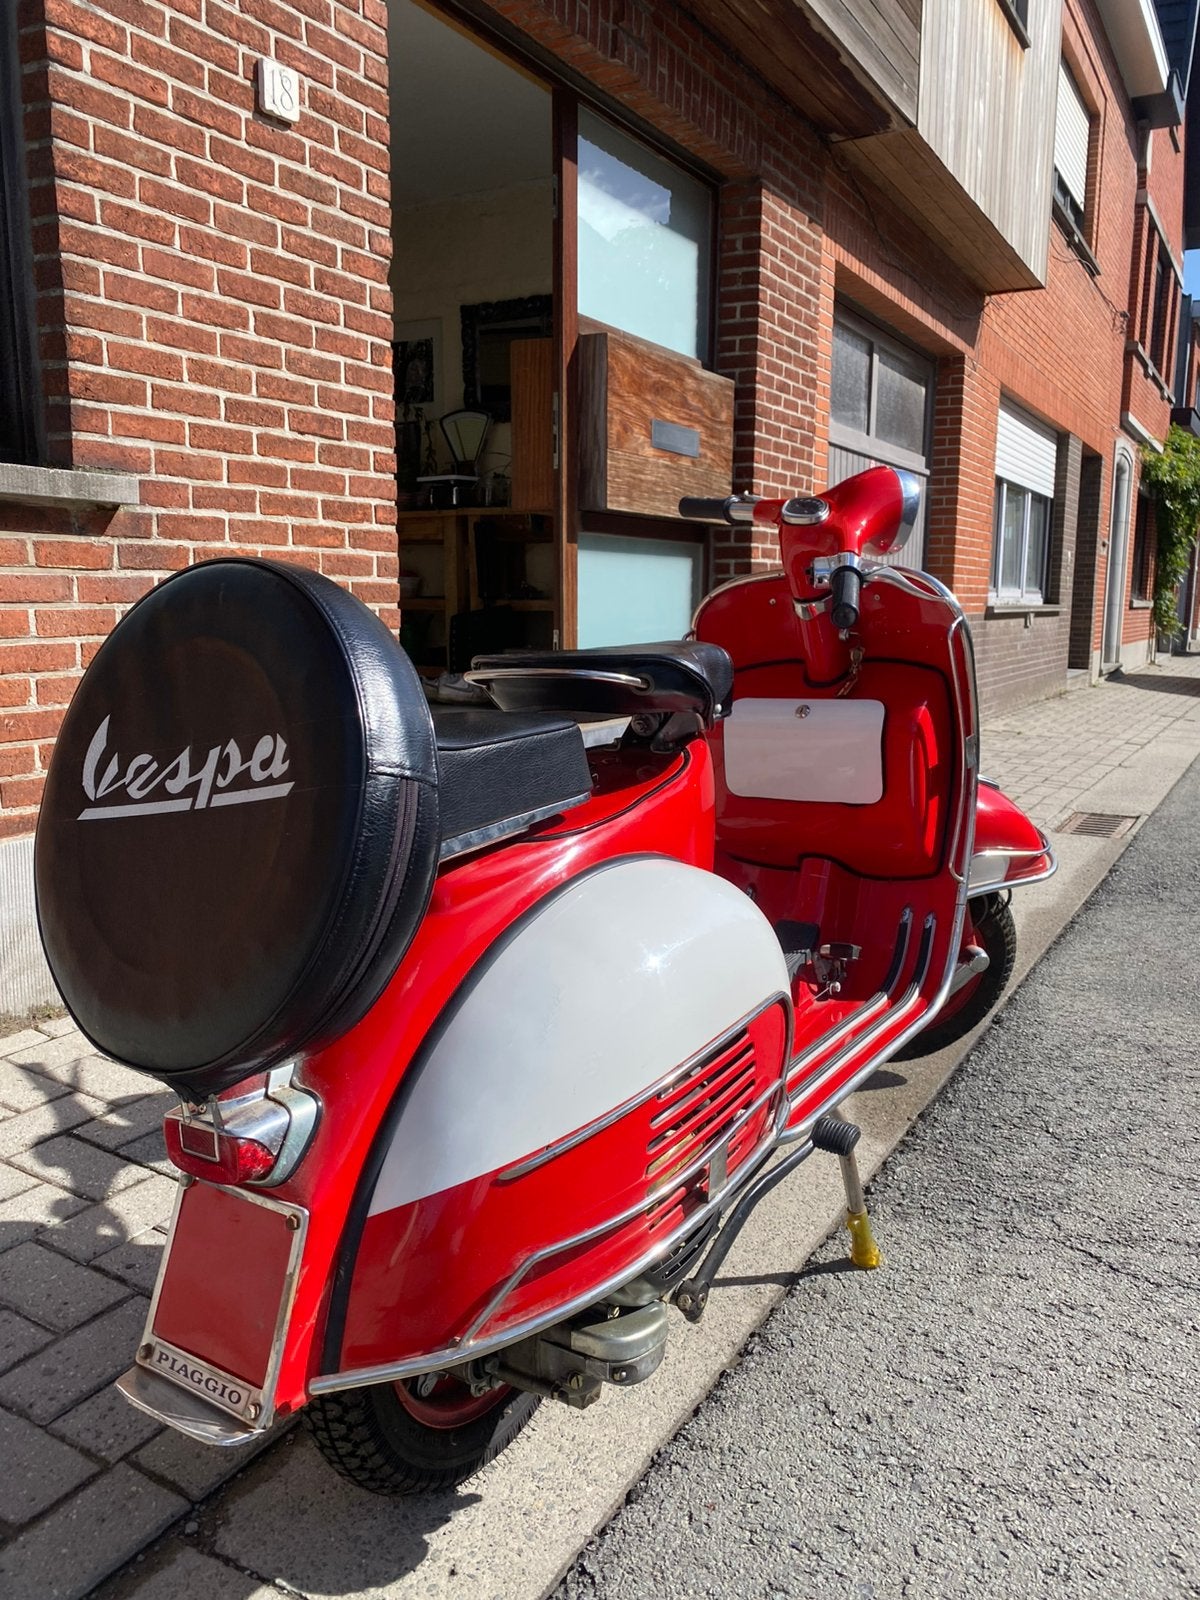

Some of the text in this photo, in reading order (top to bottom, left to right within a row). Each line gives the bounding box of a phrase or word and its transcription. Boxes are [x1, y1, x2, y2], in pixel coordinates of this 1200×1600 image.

[271, 69, 294, 111] 18
[82, 714, 290, 810] Vespa
[156, 1350, 242, 1405] PIAGGIO
